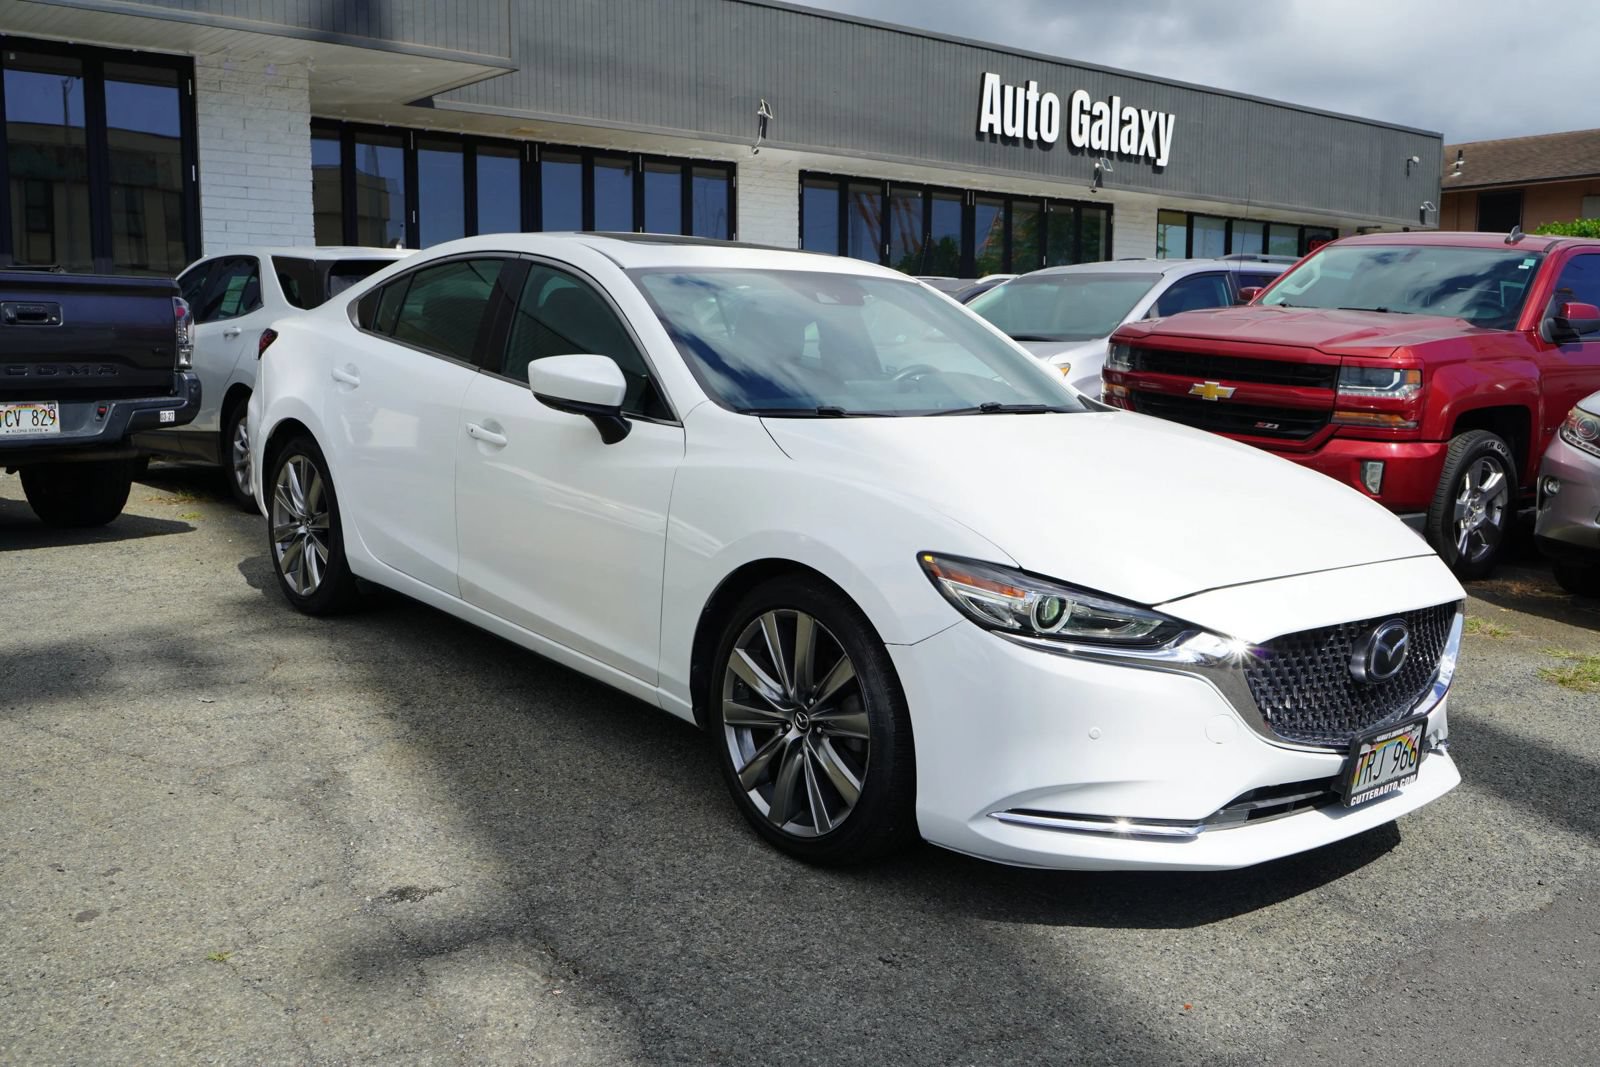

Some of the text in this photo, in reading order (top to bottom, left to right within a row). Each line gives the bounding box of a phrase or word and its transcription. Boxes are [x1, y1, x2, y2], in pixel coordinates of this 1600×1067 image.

[978, 72, 1176, 167] Auto Galaxy
[31, 408, 56, 427] 829
[1356, 734, 1419, 787] TRJ 966
[1350, 773, 1417, 807] CUTTERAUTO.COM
